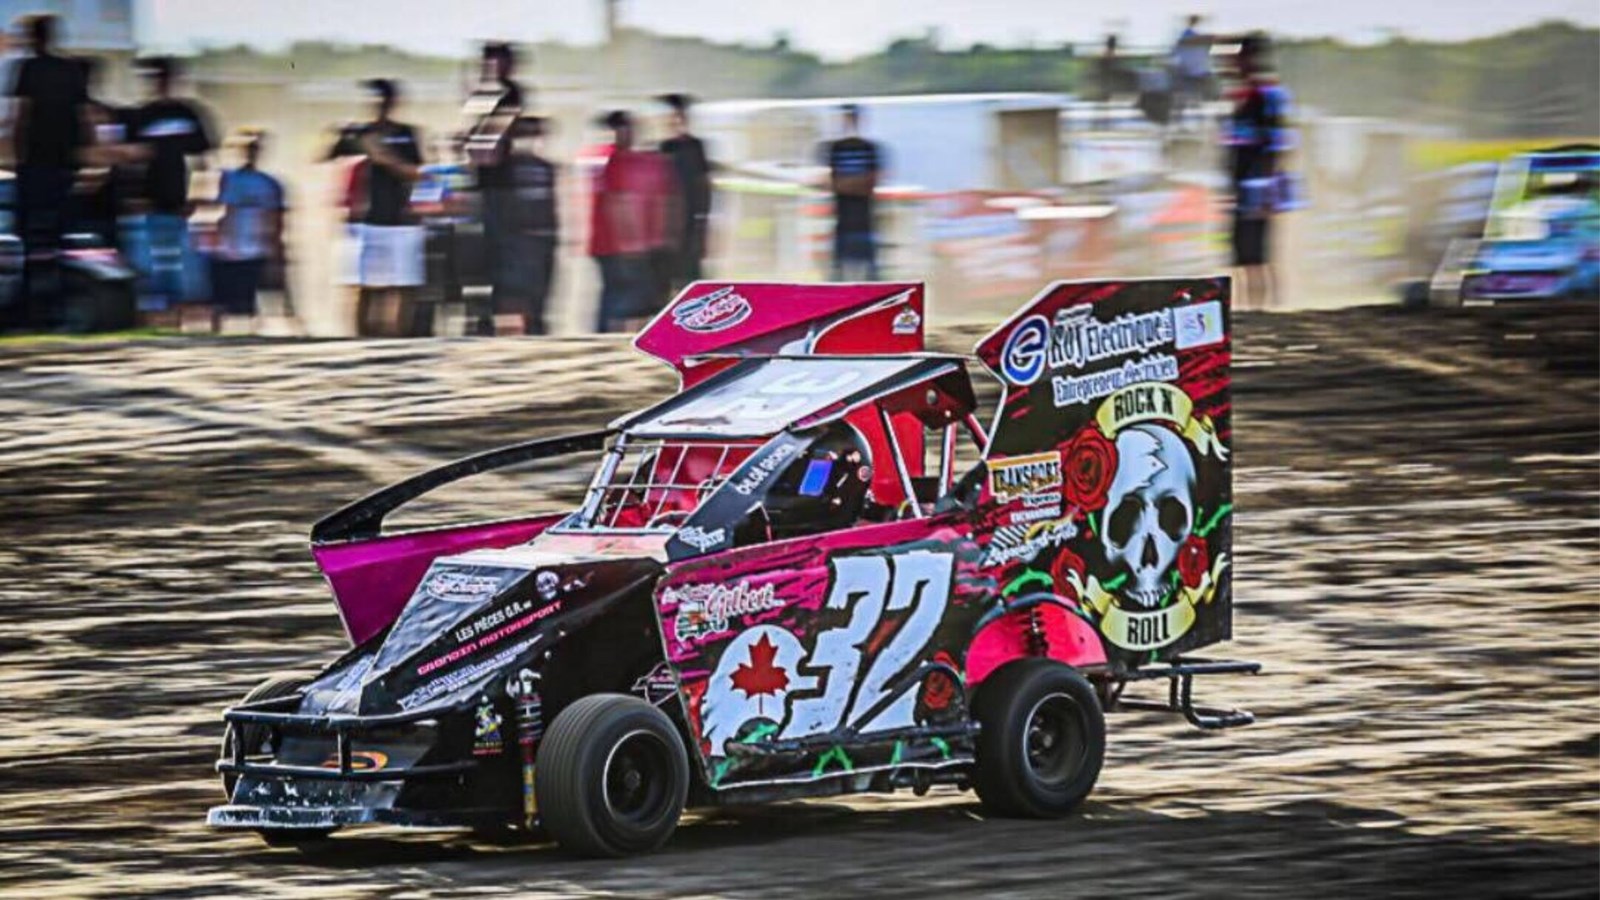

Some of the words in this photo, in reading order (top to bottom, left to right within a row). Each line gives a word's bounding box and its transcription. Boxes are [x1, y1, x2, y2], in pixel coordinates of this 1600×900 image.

[1114, 387, 1157, 421] ROCK
[455, 626, 474, 643] LES
[479, 600, 562, 648] MOTORSPORT
[1127, 612, 1170, 646] ROLL
[778, 550, 954, 740] 32
